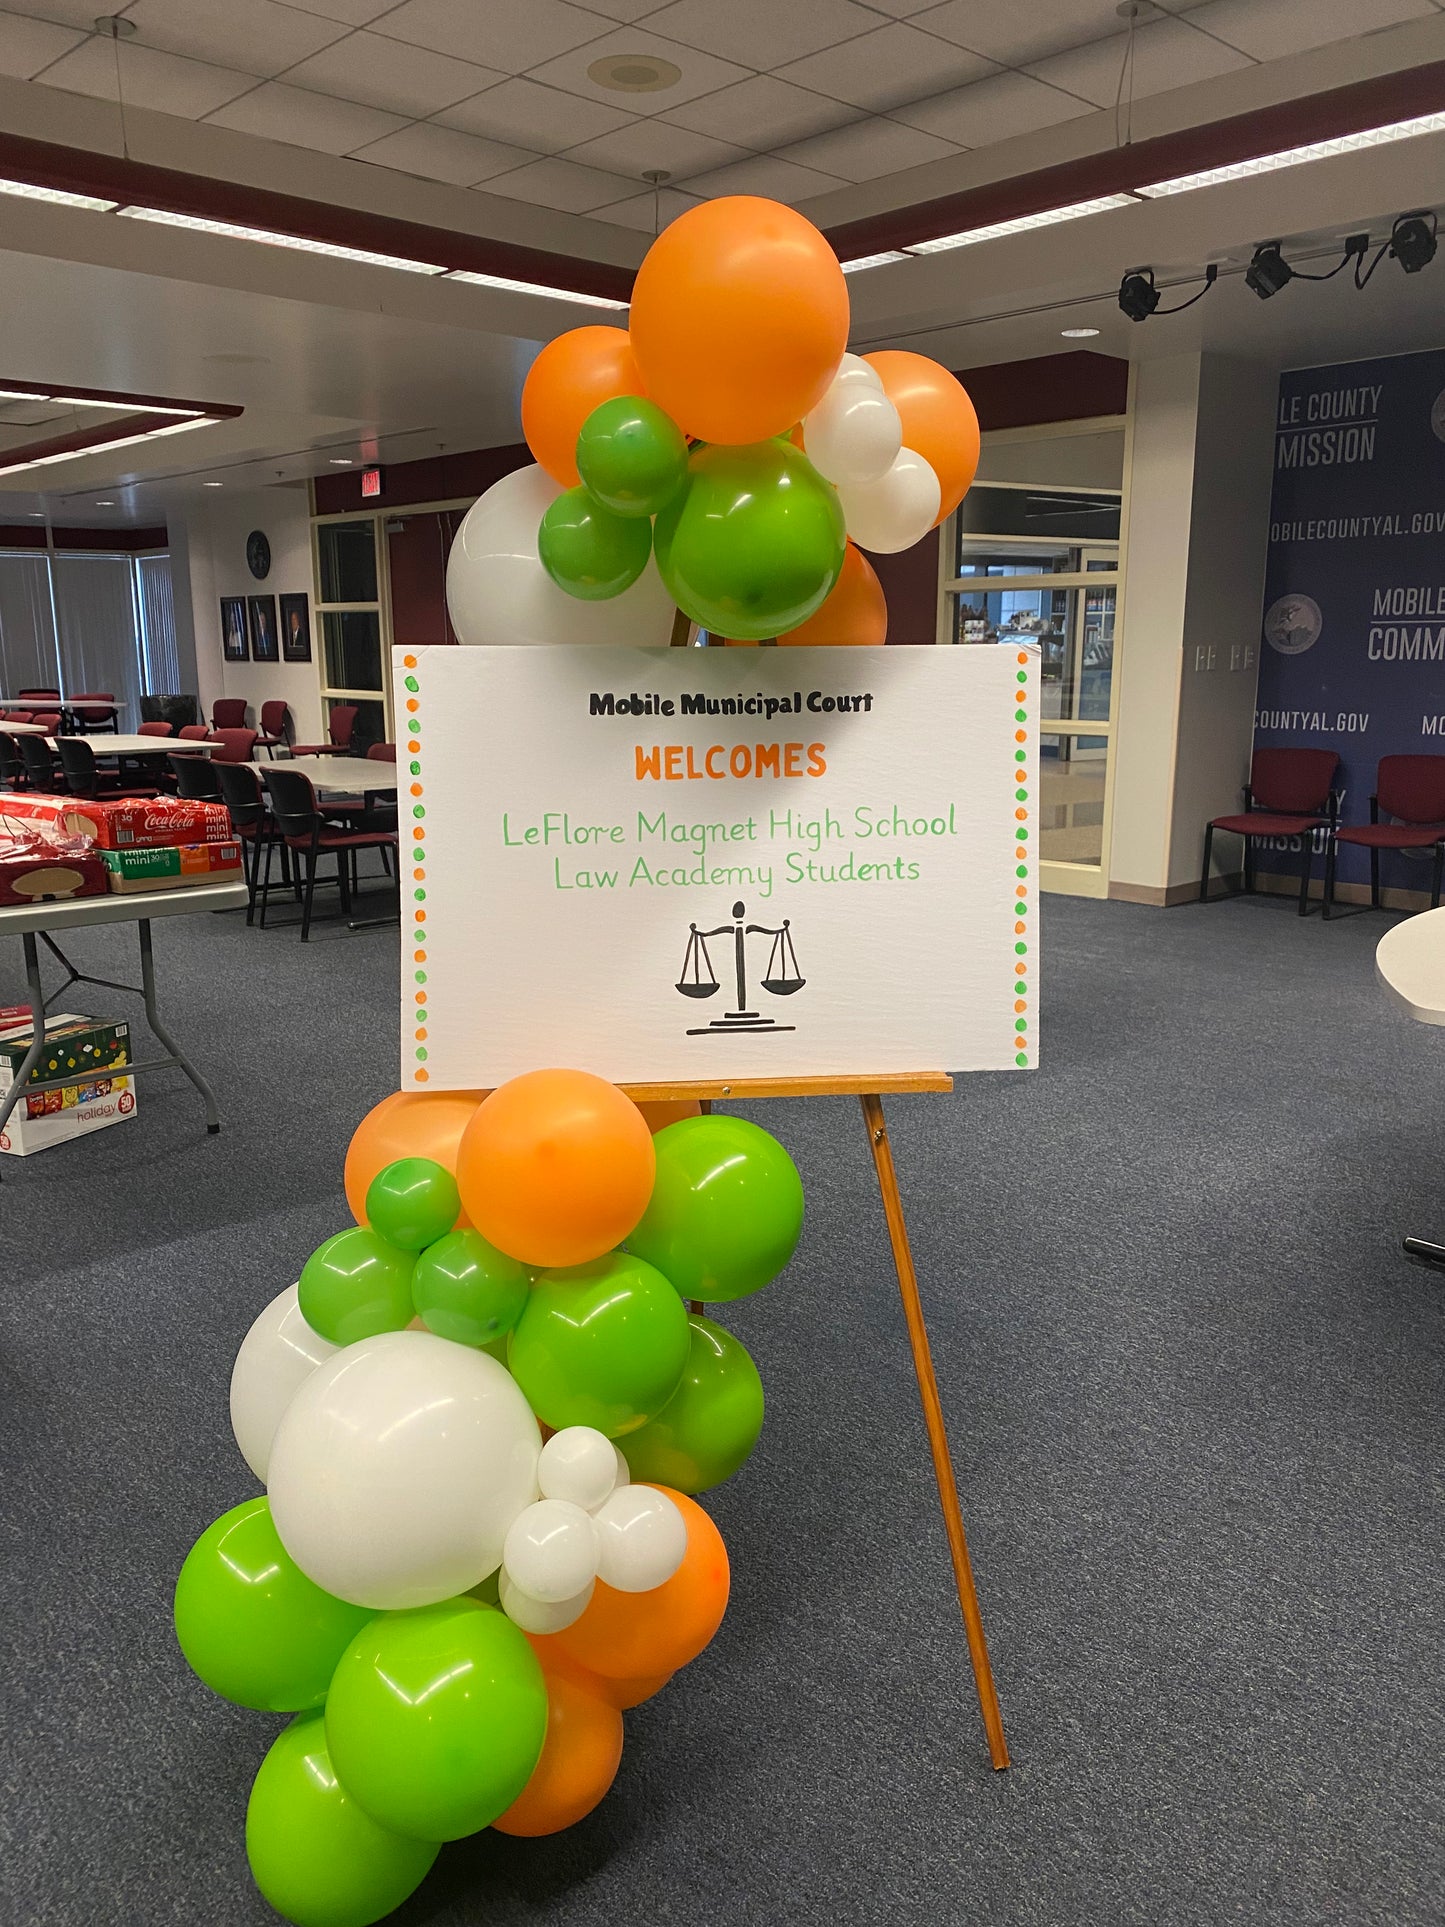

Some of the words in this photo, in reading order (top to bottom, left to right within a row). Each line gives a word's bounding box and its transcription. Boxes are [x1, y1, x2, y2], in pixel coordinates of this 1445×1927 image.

[1279, 396, 1301, 425] LE
[1307, 385, 1383, 421] COUNTY
[1278, 427, 1376, 469] MISSION
[1271, 511, 1445, 542] OBILECOUNTYAL.GOV
[590, 693, 675, 716] Mobile
[681, 692, 801, 720] Municipal
[807, 691, 873, 712] Court
[635, 743, 827, 781] WELCOMES
[206, 814, 227, 823] mini
[206, 822, 228, 832] mini
[503, 812, 625, 846] LeFlore
[637, 811, 757, 855] Magnet
[769, 808, 844, 852] High
[854, 803, 957, 839] School
[207, 832, 229, 841] mini
[125, 855, 150, 865] mini
[555, 857, 618, 889] Law
[629, 856, 773, 897] Academy
[785, 852, 920, 884] Students
[77, 1103, 117, 1123] holiday
